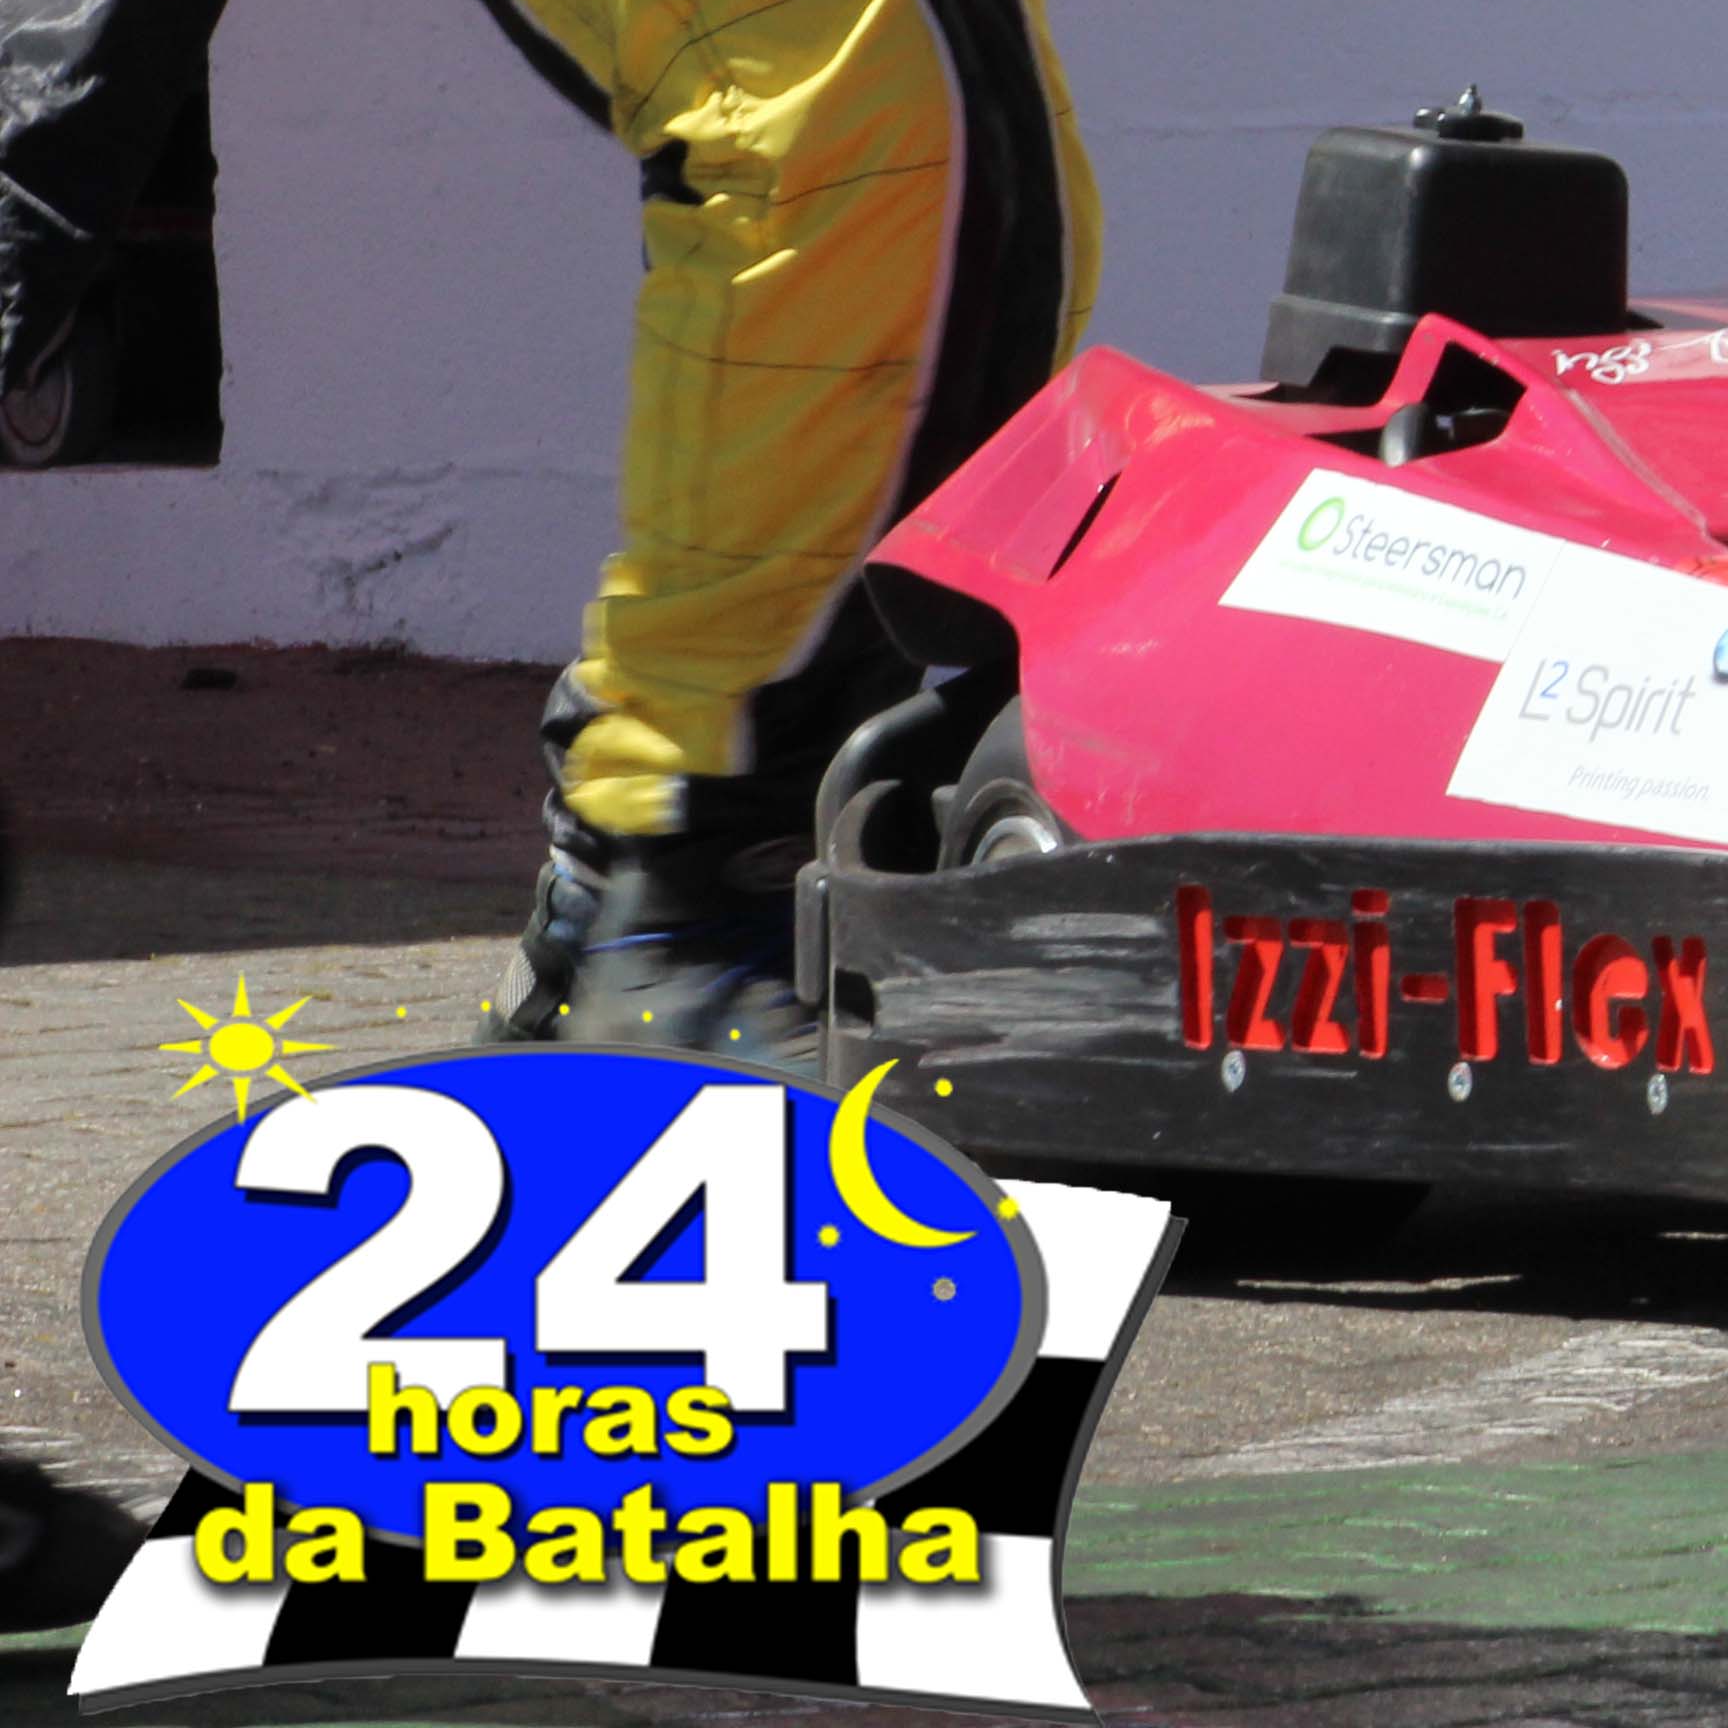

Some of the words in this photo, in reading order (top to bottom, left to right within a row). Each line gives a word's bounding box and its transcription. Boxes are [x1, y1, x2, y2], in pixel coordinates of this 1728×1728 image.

[1332, 513, 1527, 600] Steersman
[1567, 763, 1640, 801] Printing
[1175, 884, 1714, 1074] Izzi-Flex
